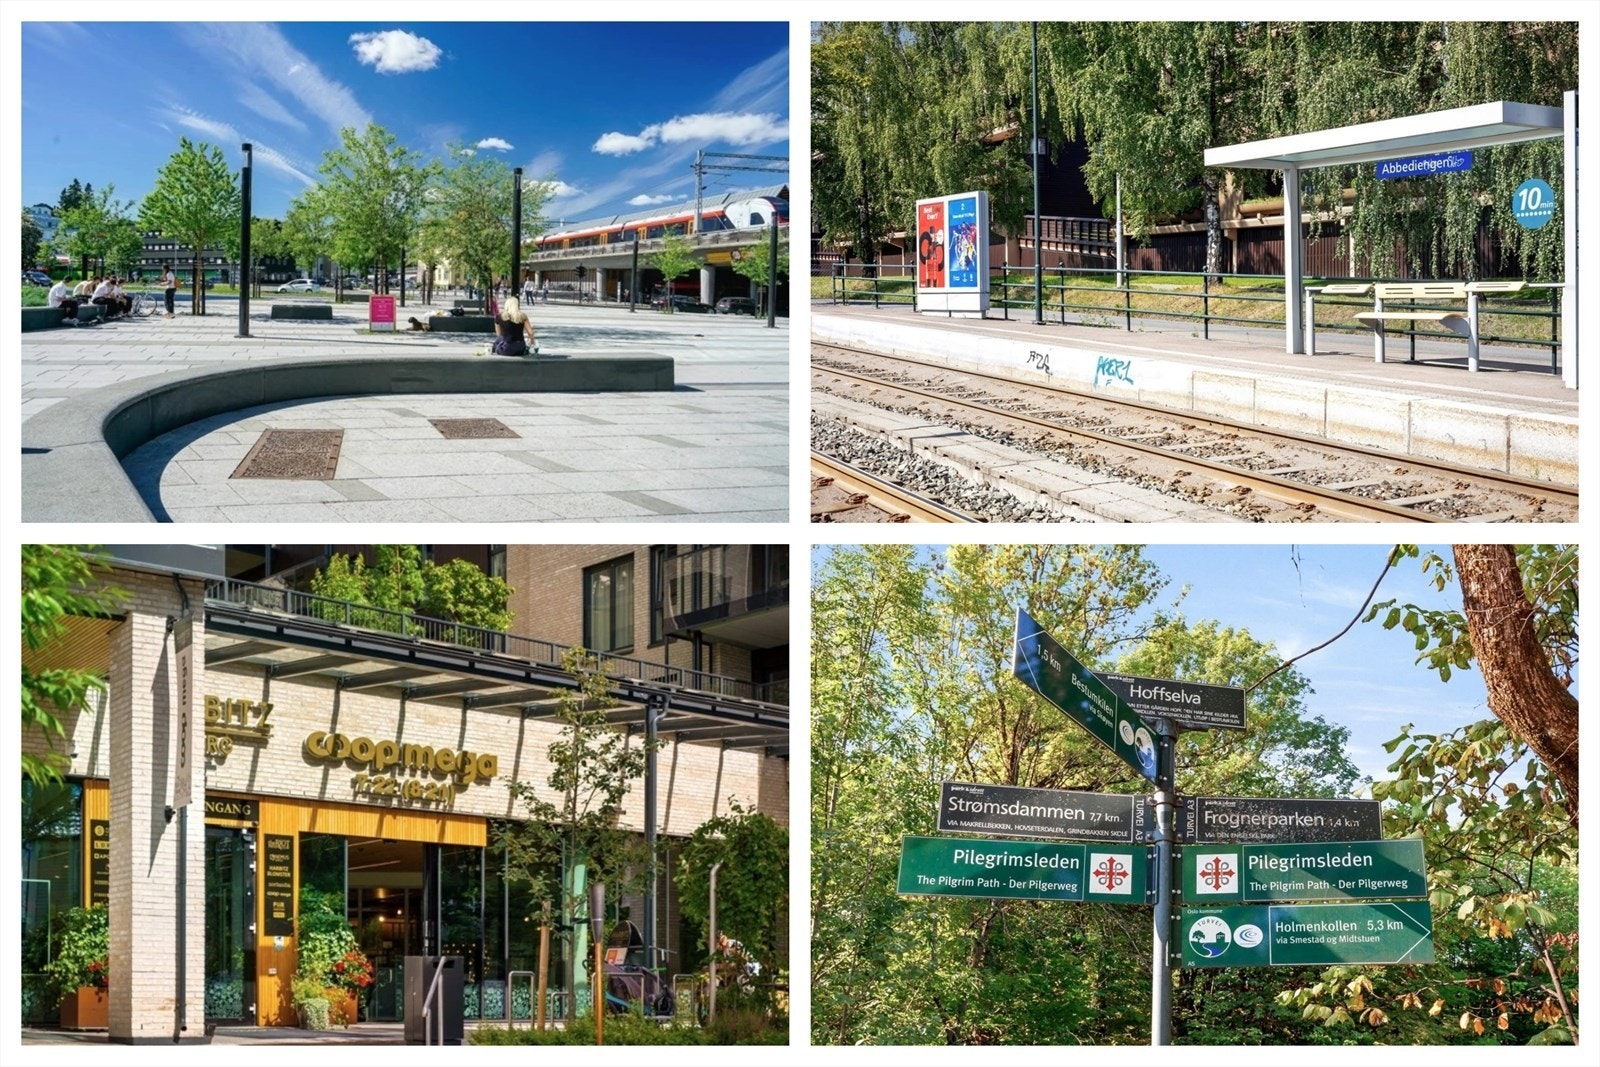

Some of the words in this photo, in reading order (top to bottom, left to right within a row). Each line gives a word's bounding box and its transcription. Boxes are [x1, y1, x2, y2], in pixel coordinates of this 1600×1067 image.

[1381, 158, 1451, 175] Abbediengen
[1518, 187, 1542, 211] 10
[1540, 201, 1554, 209] min
[1037, 644, 1049, 661] 1,5
[1049, 654, 1062, 672] km
[1071, 673, 1114, 718] Bestumkilen
[1130, 685, 1201, 705] Hoffselva
[204, 694, 274, 728] BITZ
[1089, 704, 1097, 715] via
[1096, 709, 1114, 728] Skøyen
[206, 734, 233, 755] RG
[205, 801, 251, 816] NGANG
[948, 796, 1085, 821] Strømsdammen
[1089, 812, 1102, 823] 7,7
[1135, 798, 1144, 827] TURVEI
[1187, 799, 1195, 810] A3
[1186, 810, 1195, 838] TURVEI
[1204, 810, 1324, 829] Frognerparken
[1344, 818, 1360, 827] km
[1135, 829, 1144, 841] A3
[953, 849, 1080, 869] Pilegrimsleden
[1248, 853, 1373, 872] Pilegrimsleden
[917, 875, 936, 885] The
[938, 876, 974, 888] Pilgrim
[976, 877, 1000, 888] Path
[1009, 878, 1026, 889] Der
[1028, 879, 1078, 892] Pilgerweg
[1250, 881, 1268, 891] The
[1269, 879, 1305, 892] Pilgrim
[1307, 880, 1330, 890] Path
[1338, 879, 1356, 889] Der
[1358, 878, 1408, 890] Pilgerweg
[1197, 918, 1222, 927] TURVEI
[1275, 920, 1357, 933] Holmenkollen
[1367, 920, 1384, 932] 5,3
[1387, 919, 1404, 931] km
[1276, 936, 1287, 944] via
[1289, 935, 1325, 944] Smestad
[1326, 936, 1337, 946] og
[1338, 934, 1380, 943] Midtstuen
